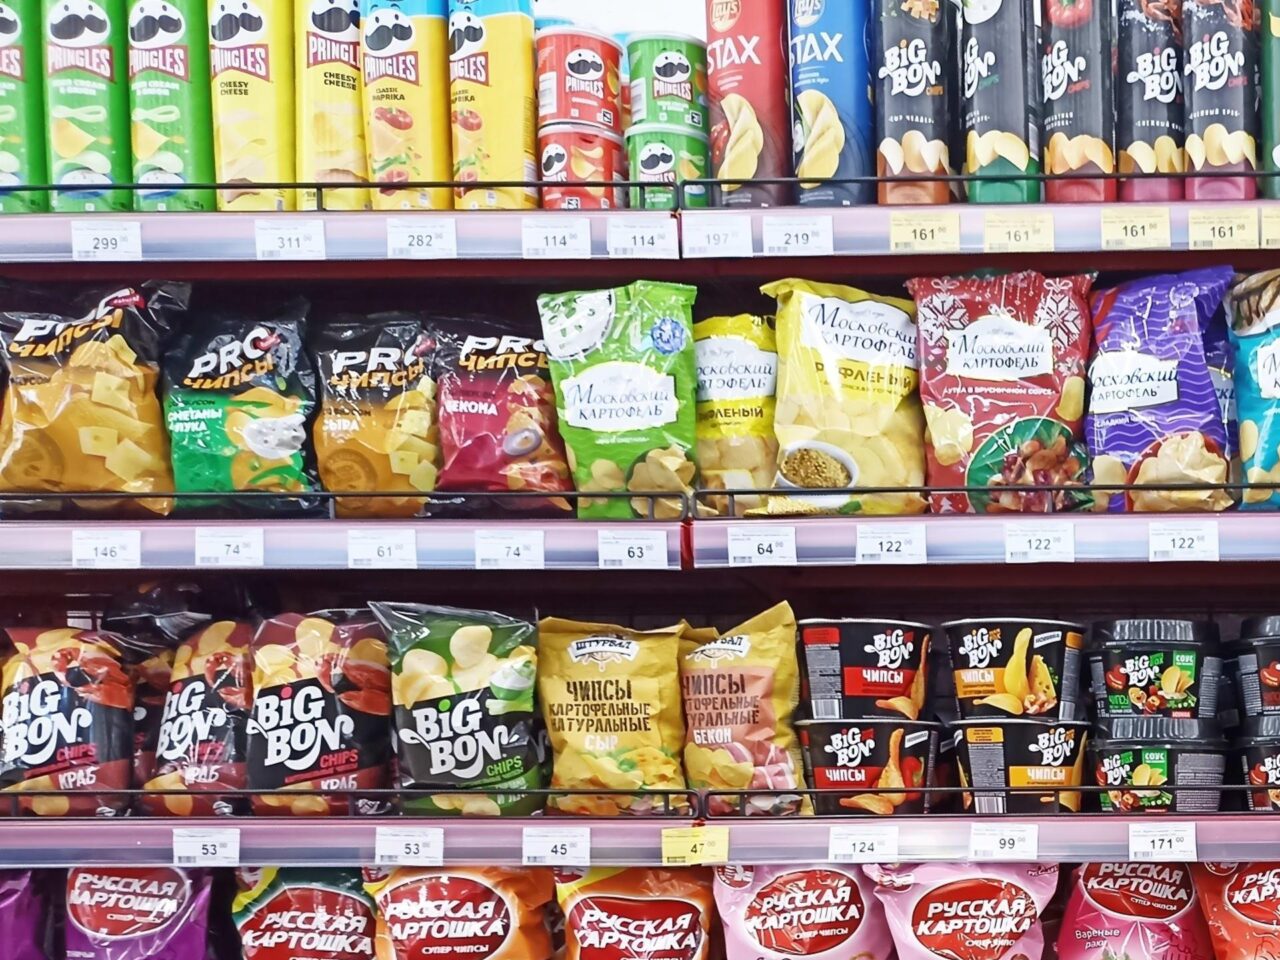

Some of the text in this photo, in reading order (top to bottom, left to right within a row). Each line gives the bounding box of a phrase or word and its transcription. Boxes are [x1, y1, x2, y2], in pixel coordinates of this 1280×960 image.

[708, 36, 760, 66] STAX
[913, 229, 934, 240] 161
[93, 238, 117, 249] 299
[408, 235, 432, 246] 282
[632, 236, 655, 246] 114
[628, 547, 643, 558] 63
[758, 544, 773, 554] 64
[862, 669, 904, 684] ЧИПСЫ
[566, 680, 632, 702] ЧИПСЫ
[694, 726, 732, 744] БЕКОН
[320, 750, 359, 767] CHIPS
[486, 756, 522, 776] CHIPS
[405, 843, 419, 854] 53
[1000, 838, 1015, 849] 99
[1151, 839, 1172, 849] 171
[202, 844, 216, 855] 53
[551, 844, 567, 855] 45
[582, 910, 691, 932] РУССКАЯ
